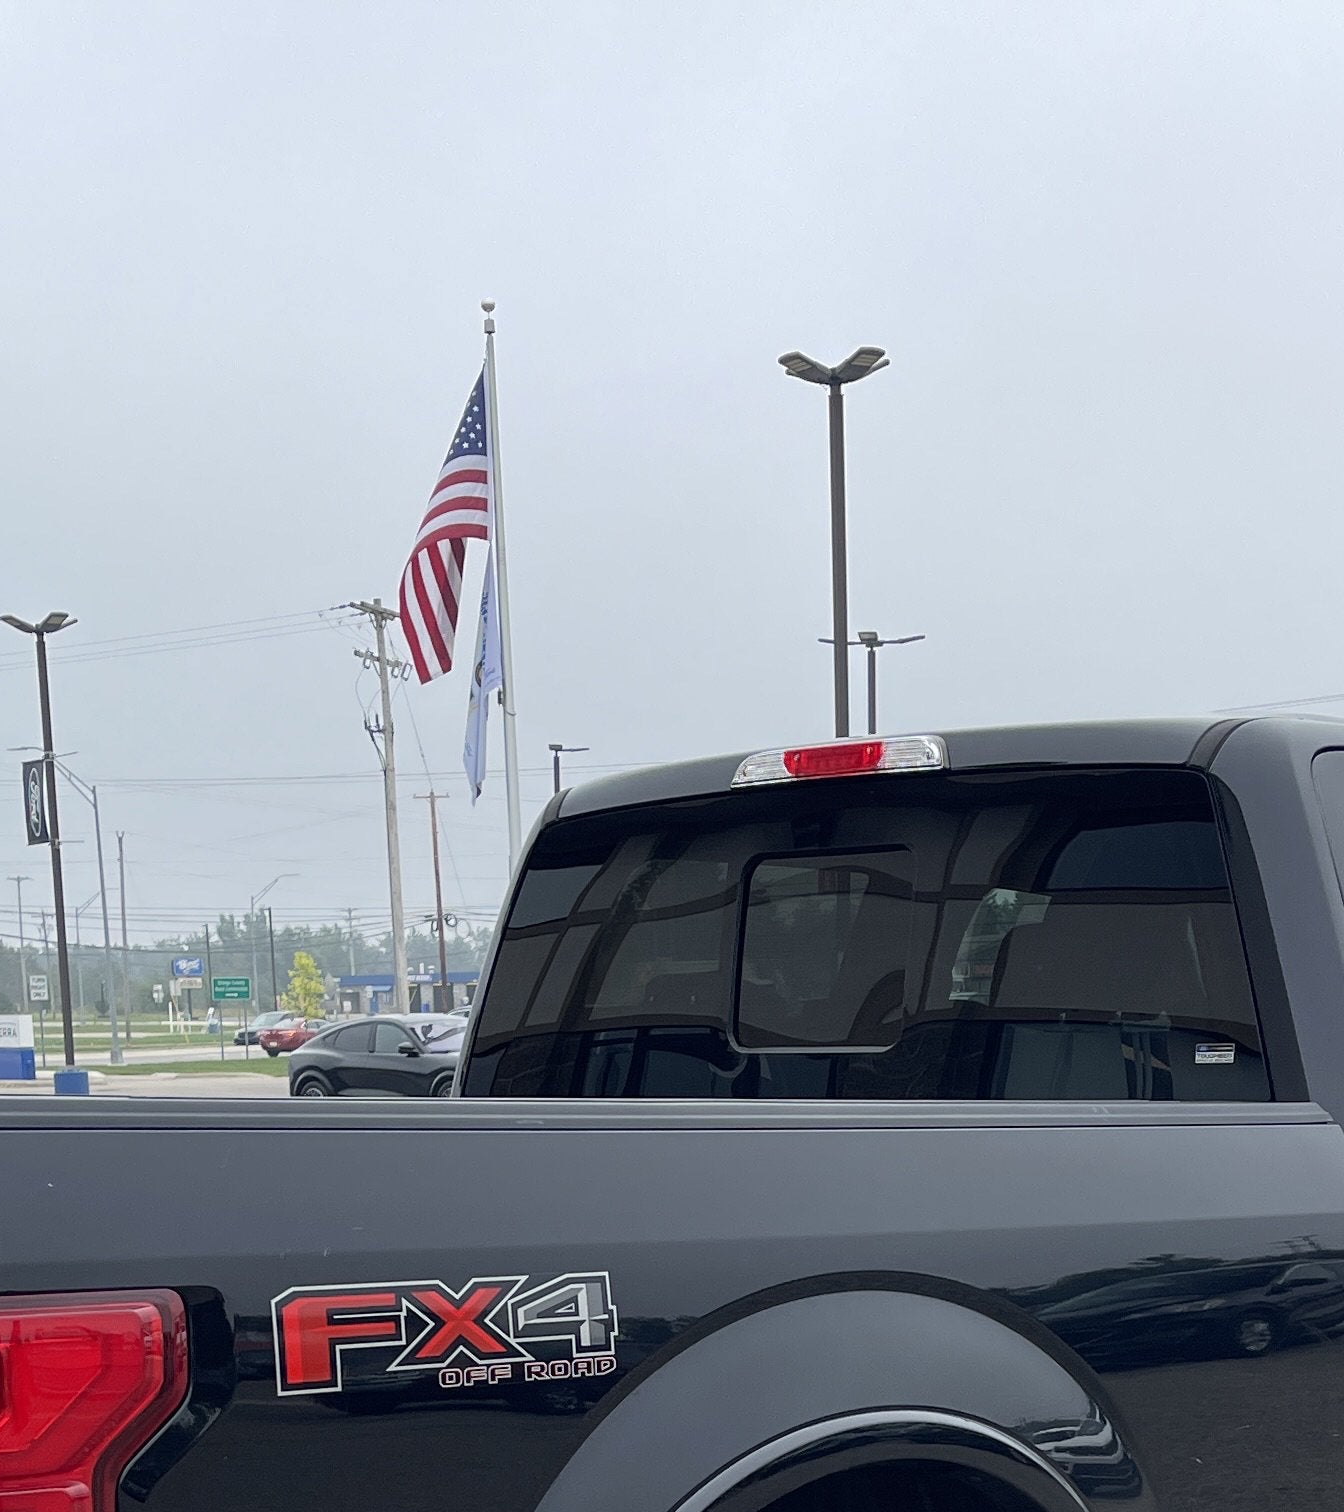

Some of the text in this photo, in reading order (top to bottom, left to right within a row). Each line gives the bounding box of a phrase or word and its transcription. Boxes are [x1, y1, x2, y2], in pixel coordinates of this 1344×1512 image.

[270, 1271, 620, 1397] FX4
[438, 1356, 618, 1389] OFF ROAD
